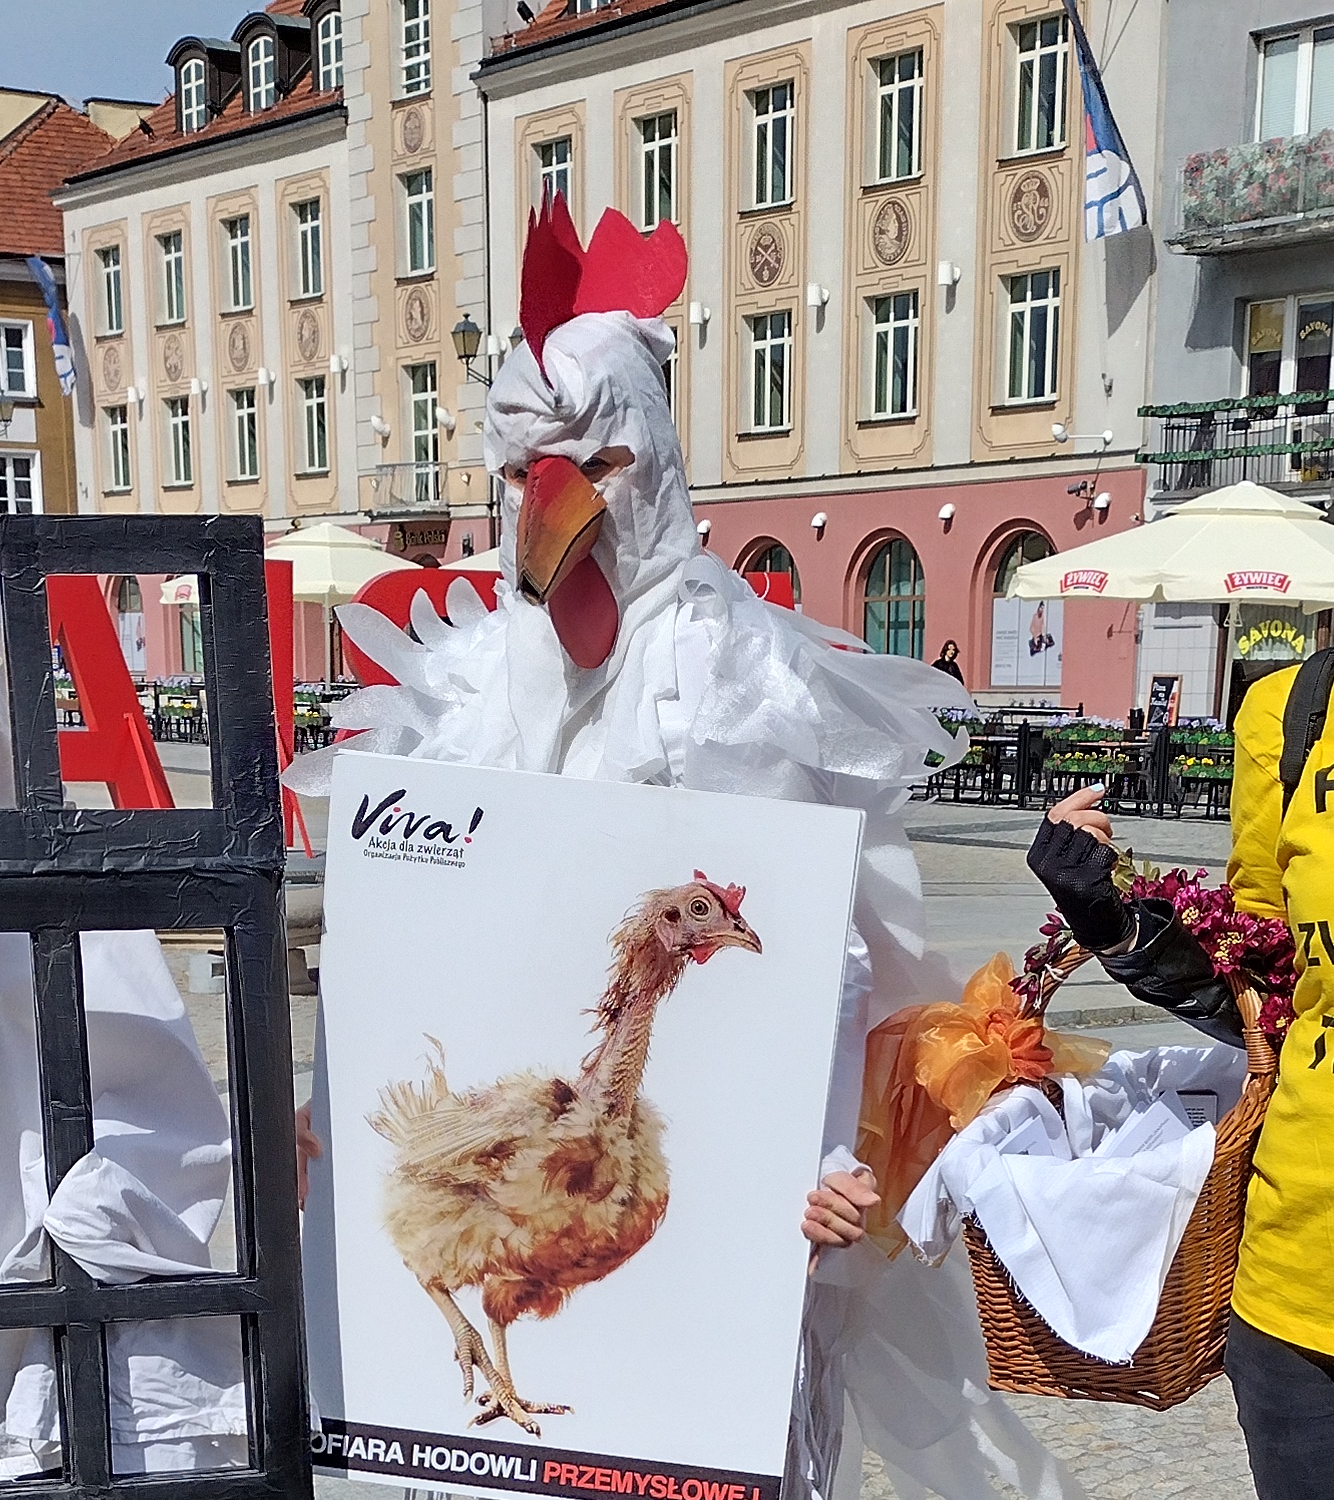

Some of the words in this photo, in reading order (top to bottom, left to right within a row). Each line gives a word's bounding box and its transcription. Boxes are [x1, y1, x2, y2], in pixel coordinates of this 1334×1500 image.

[1066, 570, 1105, 588] ŻYWIEC
[1231, 572, 1284, 588] ŻYWIEC
[1238, 619, 1306, 656] SAVONA
[351, 788, 484, 844] Viva!
[363, 849, 401, 861] Organizacja
[402, 853, 429, 864] Pożytku
[430, 856, 466, 869] Publicznego
[368, 836, 396, 851] Akcja
[399, 839, 414, 852] dla
[417, 844, 464, 859] zwierząt
[310, 1432, 404, 1465] OFIARA
[412, 1444, 537, 1483] HODOWLI
